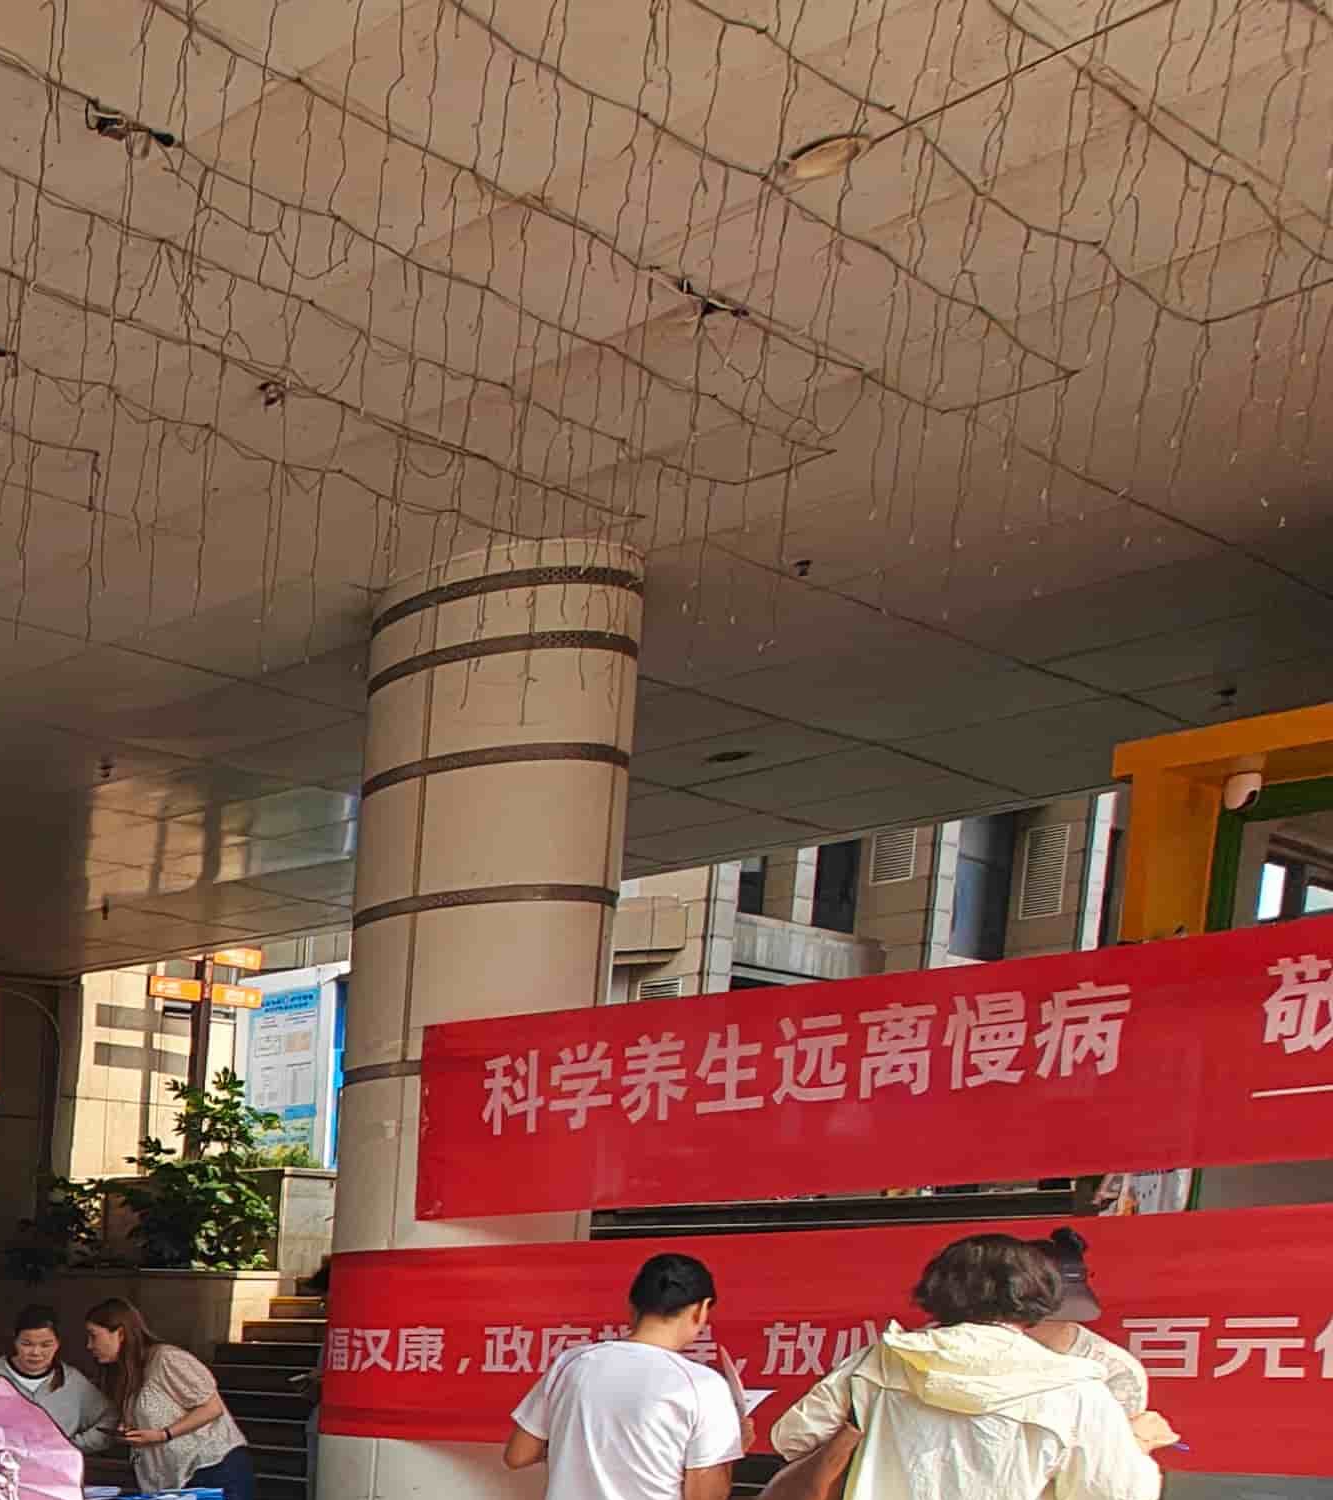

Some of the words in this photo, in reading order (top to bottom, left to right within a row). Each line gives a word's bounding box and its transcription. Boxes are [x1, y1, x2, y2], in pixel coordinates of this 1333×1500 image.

[481, 980, 1131, 1136] 科学养生远离慢病
